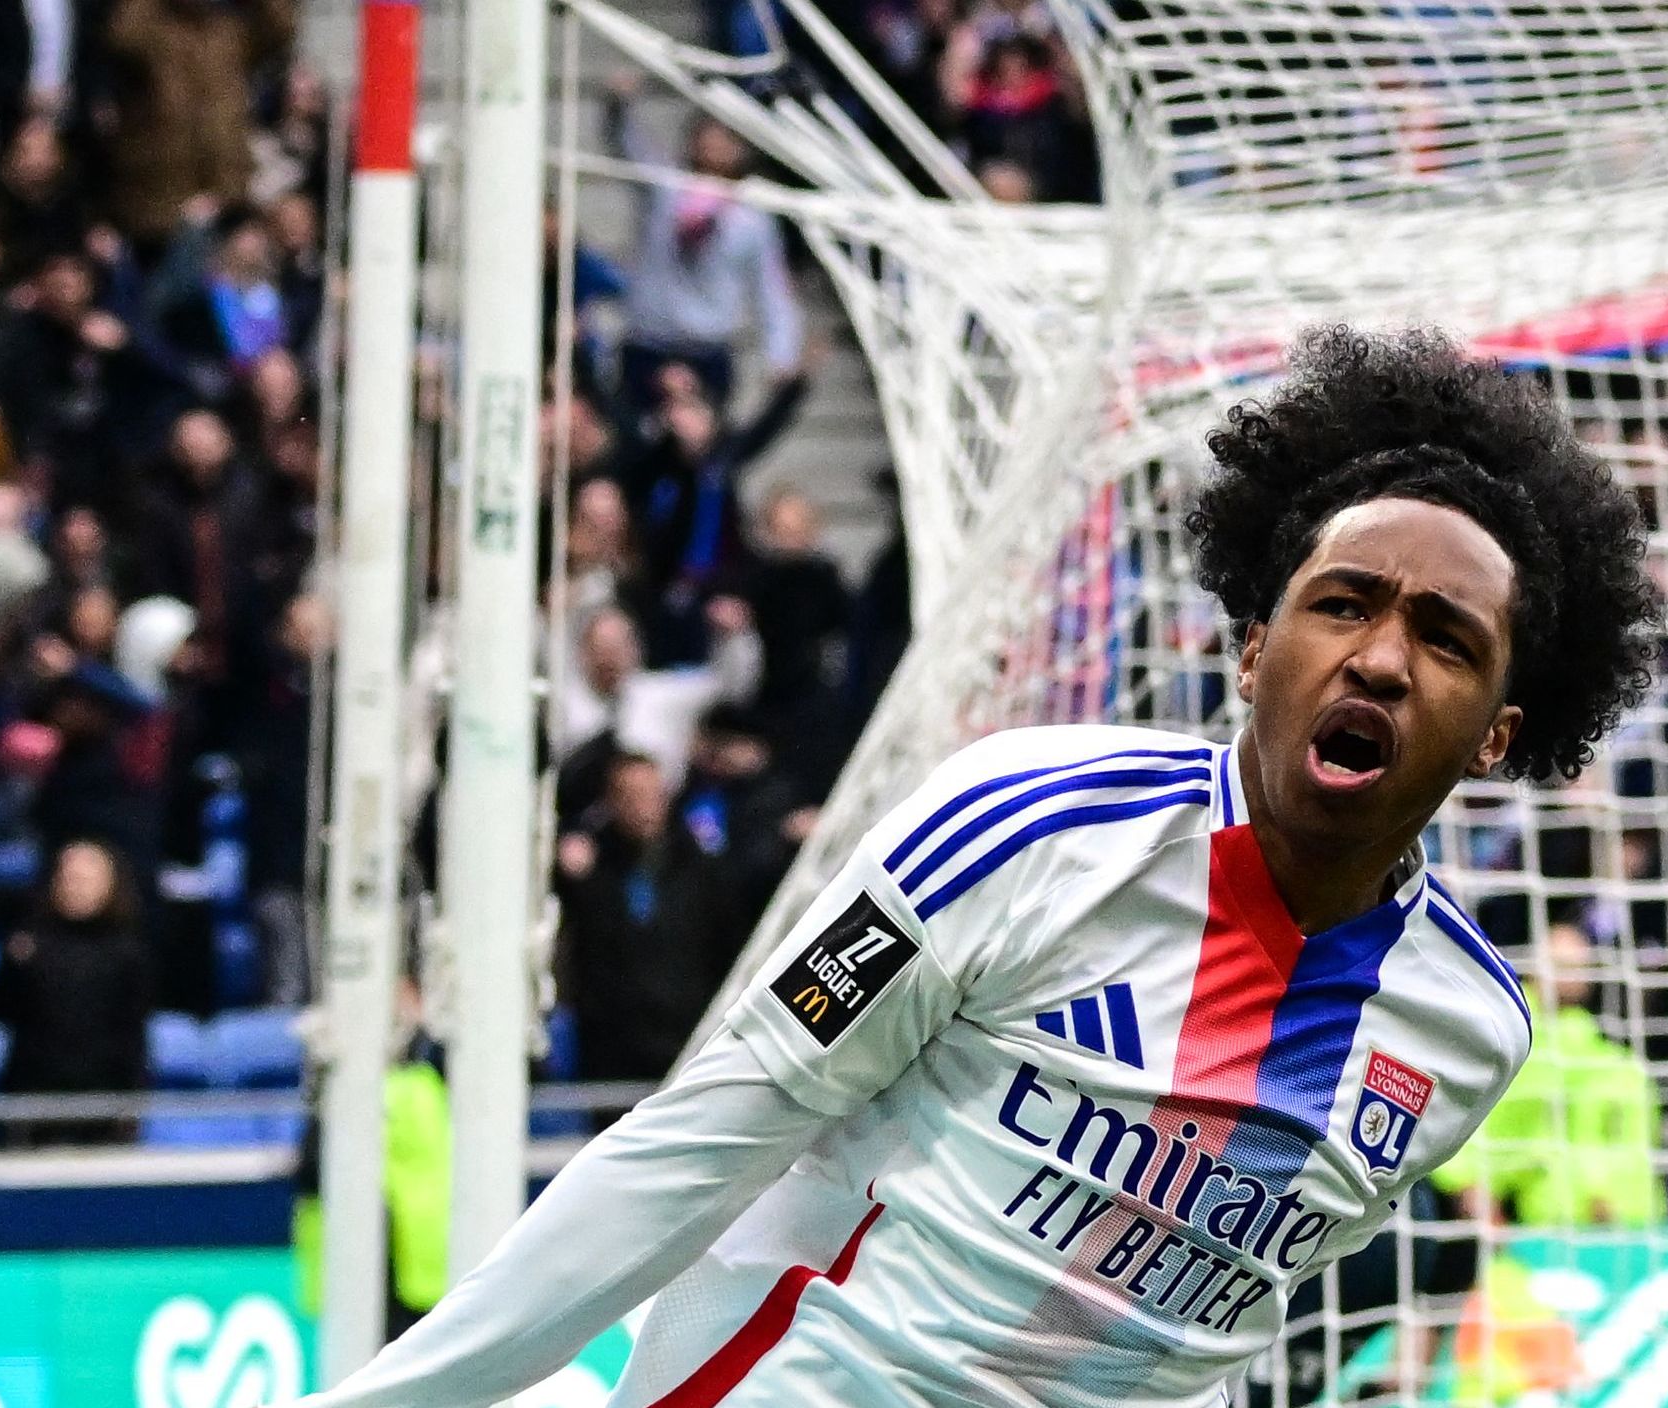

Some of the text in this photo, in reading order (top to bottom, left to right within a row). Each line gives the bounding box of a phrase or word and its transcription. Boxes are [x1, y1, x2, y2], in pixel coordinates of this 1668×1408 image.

[1369, 1070, 1423, 1111] LYONNAIS
[1373, 1059, 1428, 1097] OLYMPIQUE
[1359, 1101, 1406, 1162] OL
[998, 1061, 1341, 1273] Emirate
[1003, 1165, 1273, 1333] FLY BETTER
